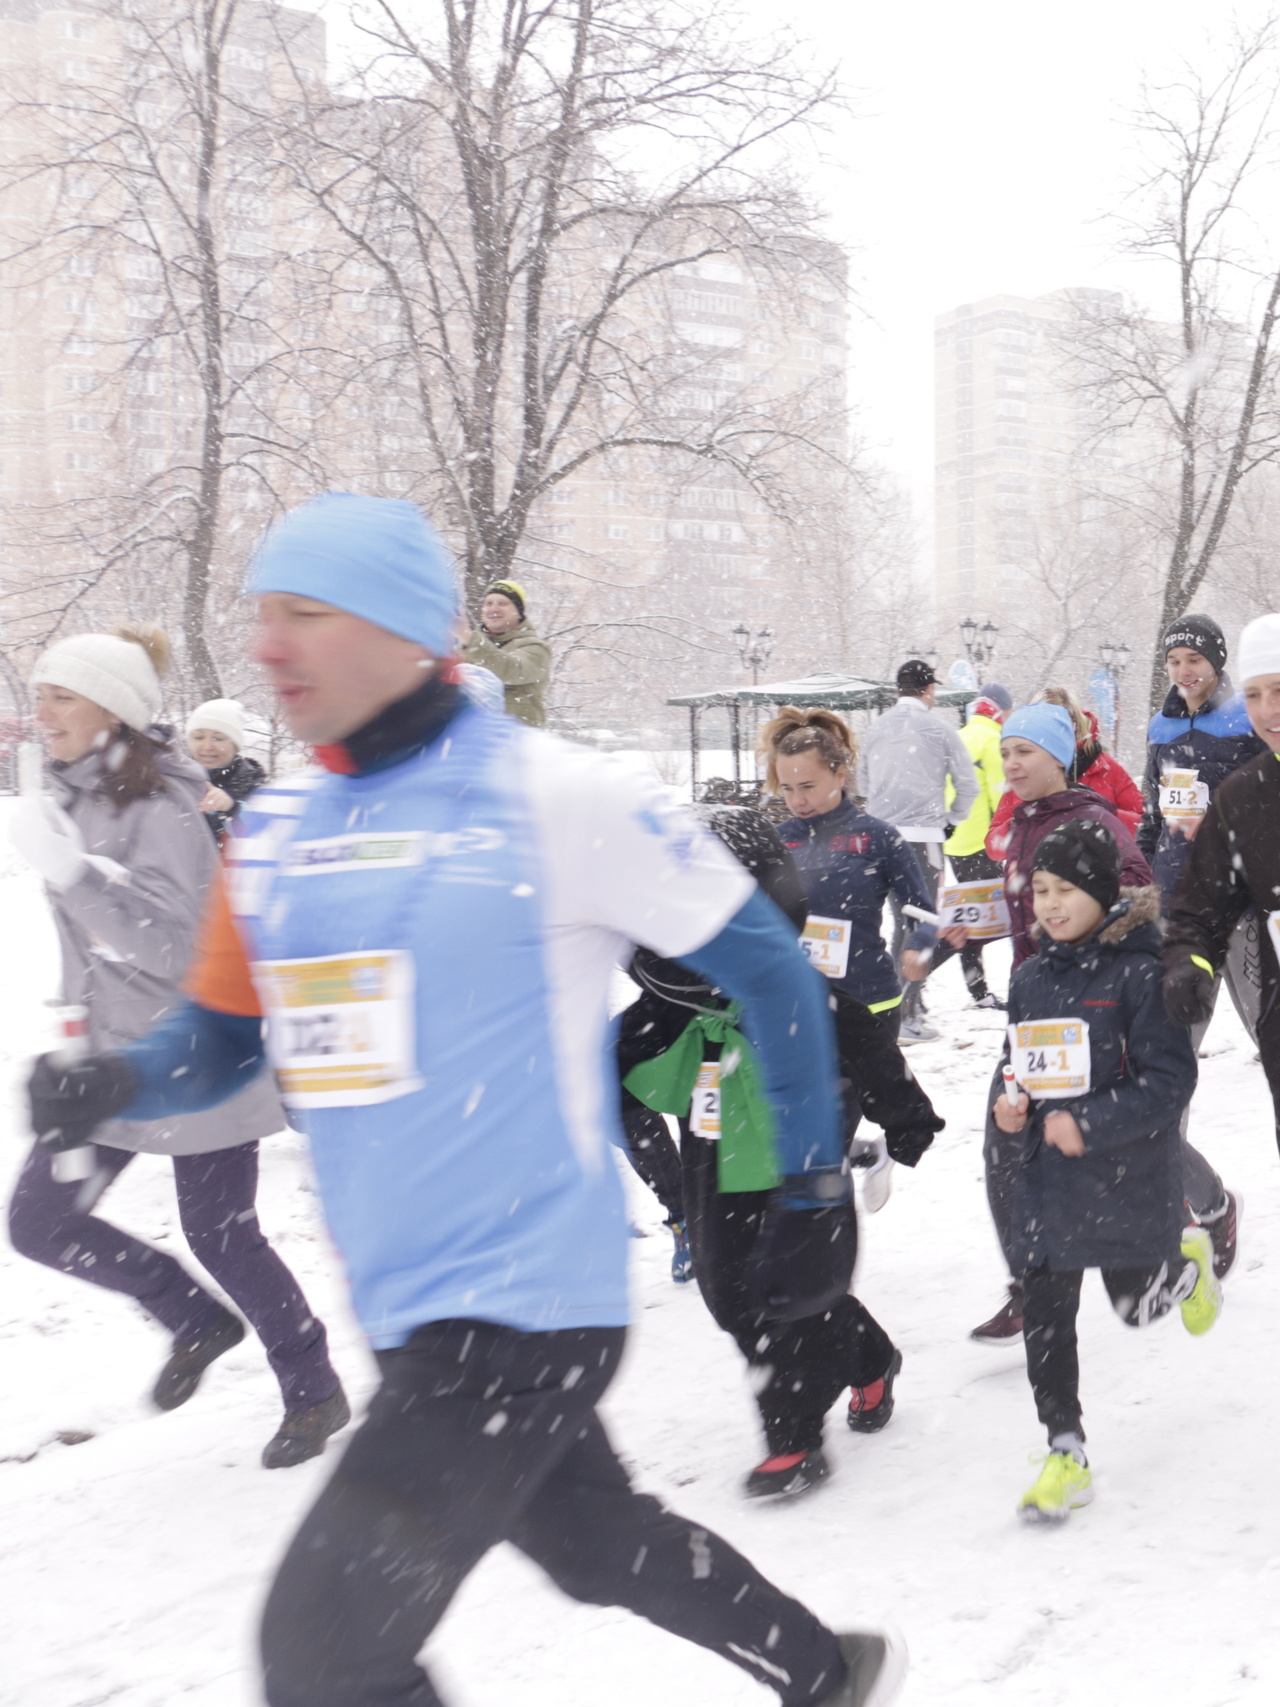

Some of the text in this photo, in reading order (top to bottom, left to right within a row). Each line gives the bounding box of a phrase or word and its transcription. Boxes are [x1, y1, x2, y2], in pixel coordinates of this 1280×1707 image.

[1165, 632, 1203, 646] sport
[1169, 790, 1198, 805] 51-2
[953, 905, 998, 923] 29-1
[801, 941, 831, 960] 5-1
[1027, 1050, 1070, 1073] 24-1
